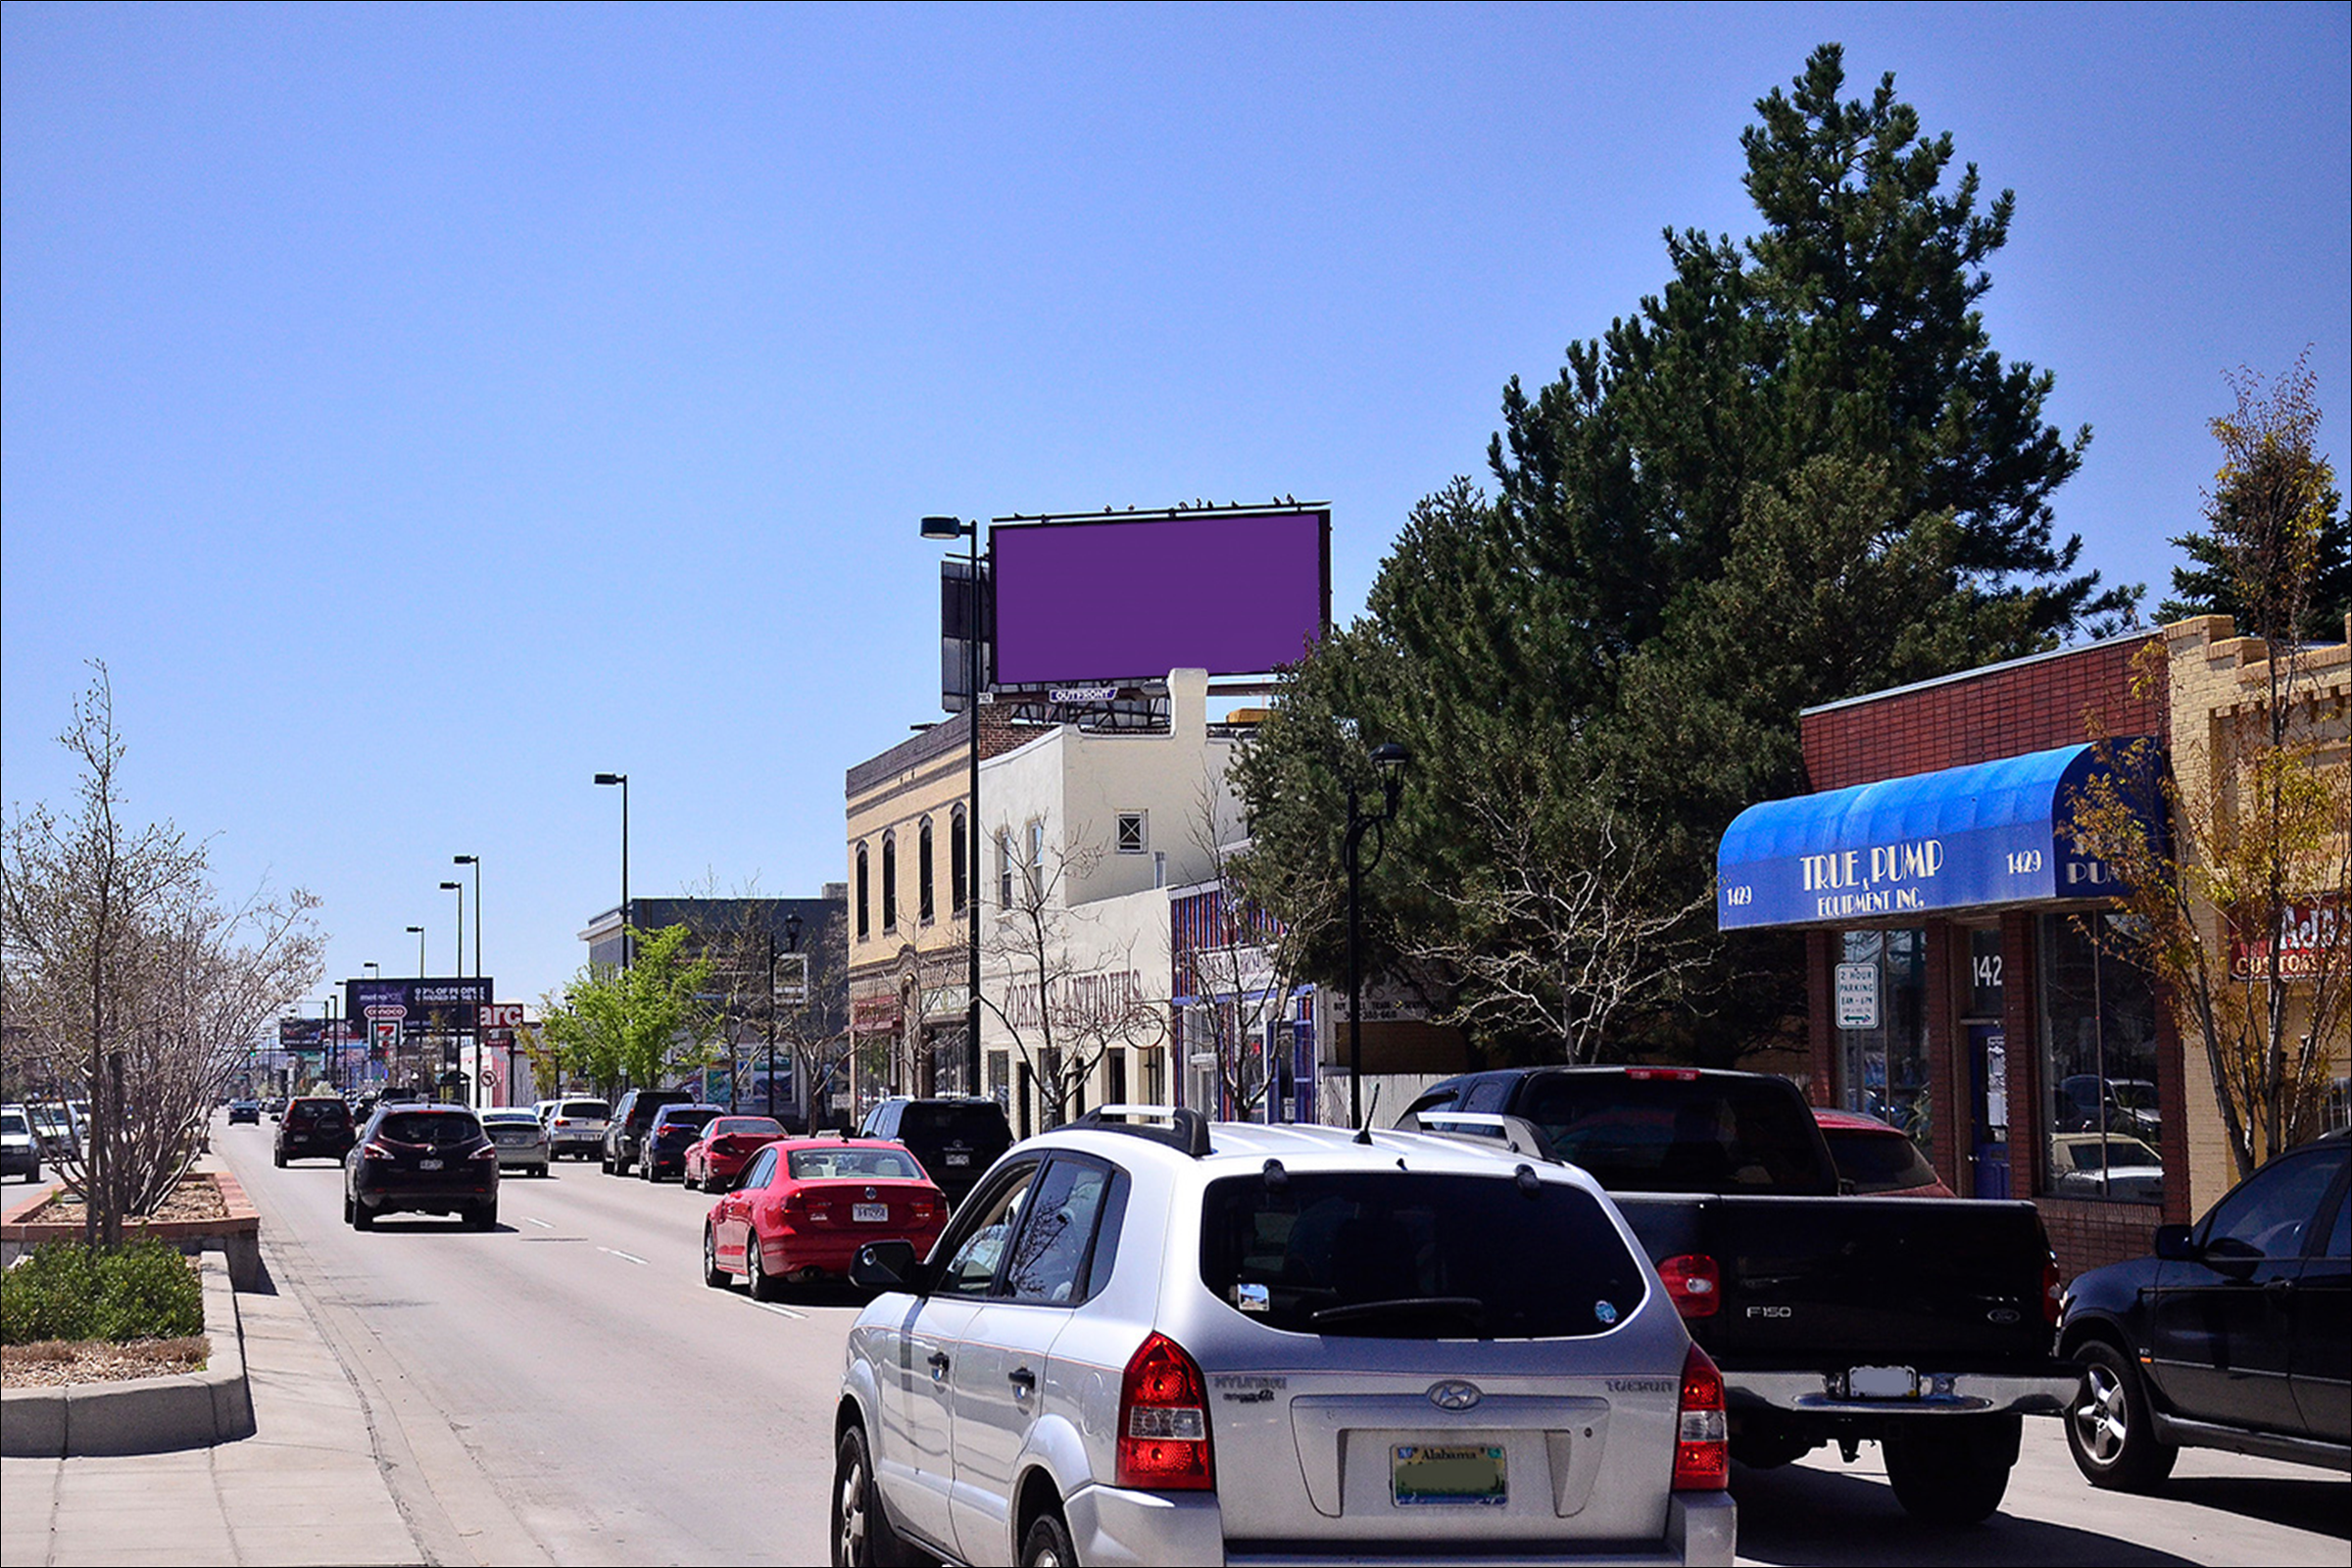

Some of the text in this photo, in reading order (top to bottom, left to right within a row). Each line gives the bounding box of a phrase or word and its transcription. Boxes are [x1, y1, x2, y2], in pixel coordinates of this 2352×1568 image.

[1056, 688, 1109, 702] OUTFRONT
[1799, 840, 1943, 891] TRUE PUMP
[2006, 850, 2042, 874] 1429
[1726, 885, 1752, 906] 1429
[1818, 890, 1890, 917] EQUIPMENT
[1840, 971, 1872, 980] 2 HOUR
[1063, 969, 1144, 1024] ANTIQUES
[1840, 983, 1873, 992] PARKING
[477, 1005, 522, 1026] arc
[1214, 1376, 1287, 1390] HYUNDAI
[1422, 1449, 1477, 1460] Alabama
